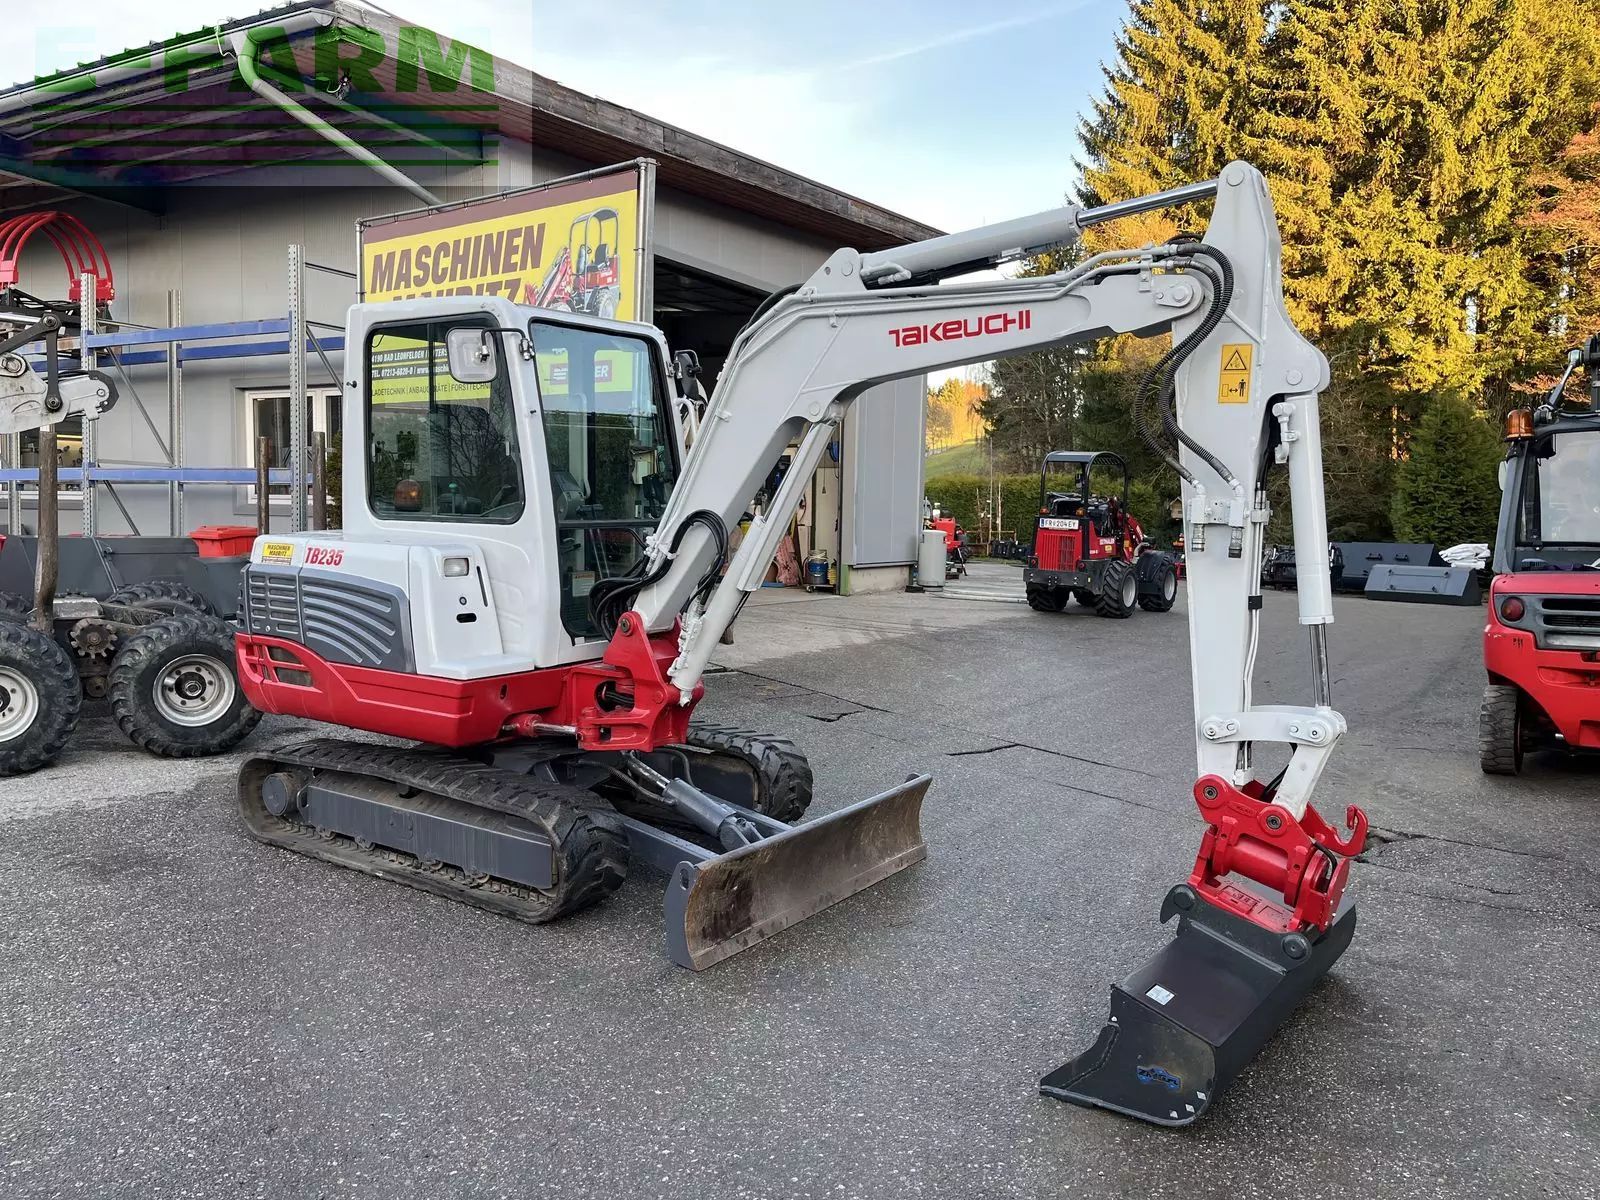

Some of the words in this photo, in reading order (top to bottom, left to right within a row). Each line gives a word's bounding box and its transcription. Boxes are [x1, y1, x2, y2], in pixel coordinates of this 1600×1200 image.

[370, 222, 546, 294] MASCHINEN
[888, 309, 1031, 347] TAKEUCHI
[384, 352, 393, 360] BAD
[394, 348, 424, 359] LEONFELDEN
[304, 547, 344, 567] TB235
